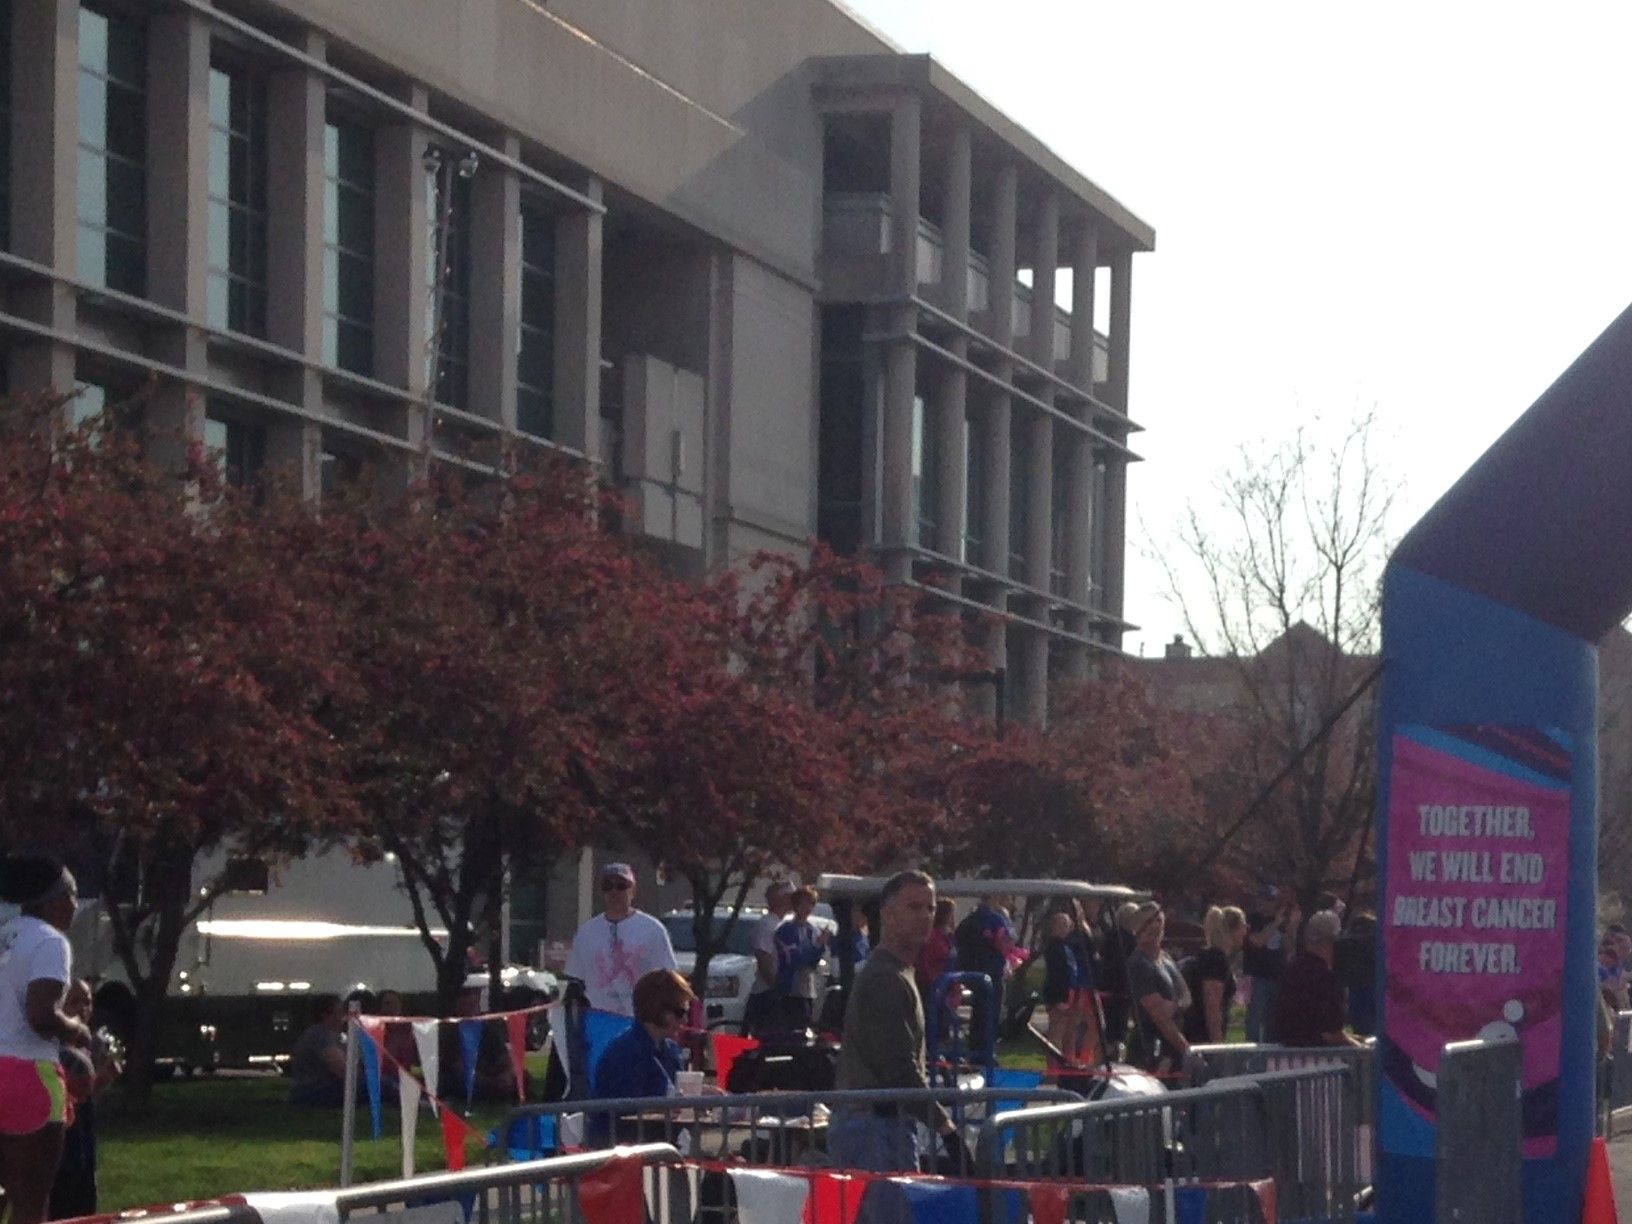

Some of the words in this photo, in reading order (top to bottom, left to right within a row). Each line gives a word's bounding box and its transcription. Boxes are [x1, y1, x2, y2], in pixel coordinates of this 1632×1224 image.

[1418, 803, 1536, 841] TOGETHER,
[1409, 850, 1437, 882] WE
[1441, 850, 1494, 883] WILL
[1501, 852, 1545, 884] END
[1392, 894, 1468, 928] BREAST
[1471, 896, 1557, 930] CANCER
[1419, 941, 1522, 975] FOREVER.
